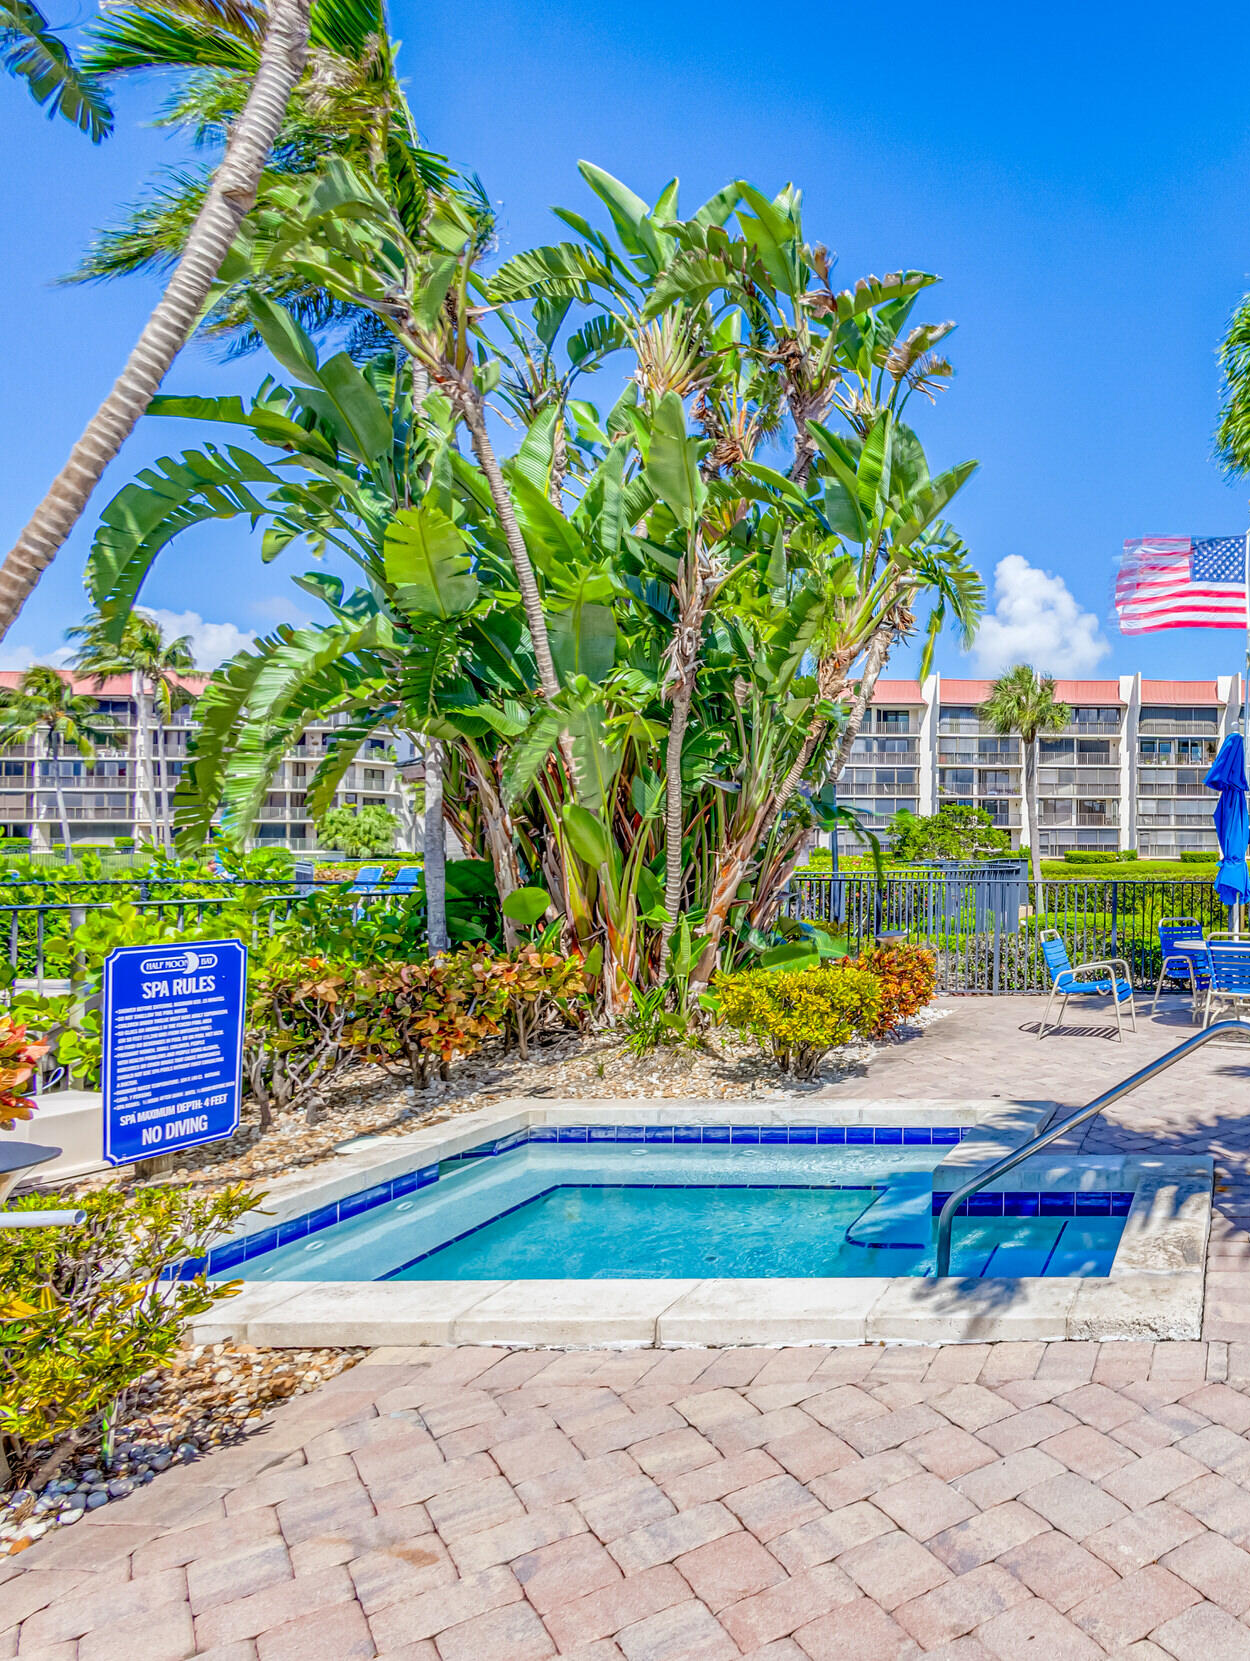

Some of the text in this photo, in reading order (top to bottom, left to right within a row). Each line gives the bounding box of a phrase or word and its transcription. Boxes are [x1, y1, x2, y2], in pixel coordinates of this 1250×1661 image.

[146, 961, 164, 970] HALF
[142, 975, 216, 999] SPA RULES
[120, 1113, 136, 1126] SPA
[137, 1105, 176, 1122] MAXIMUM
[203, 1097, 209, 1107] 4
[210, 1093, 228, 1106] FEET
[142, 1114, 208, 1146] NO DIVING
